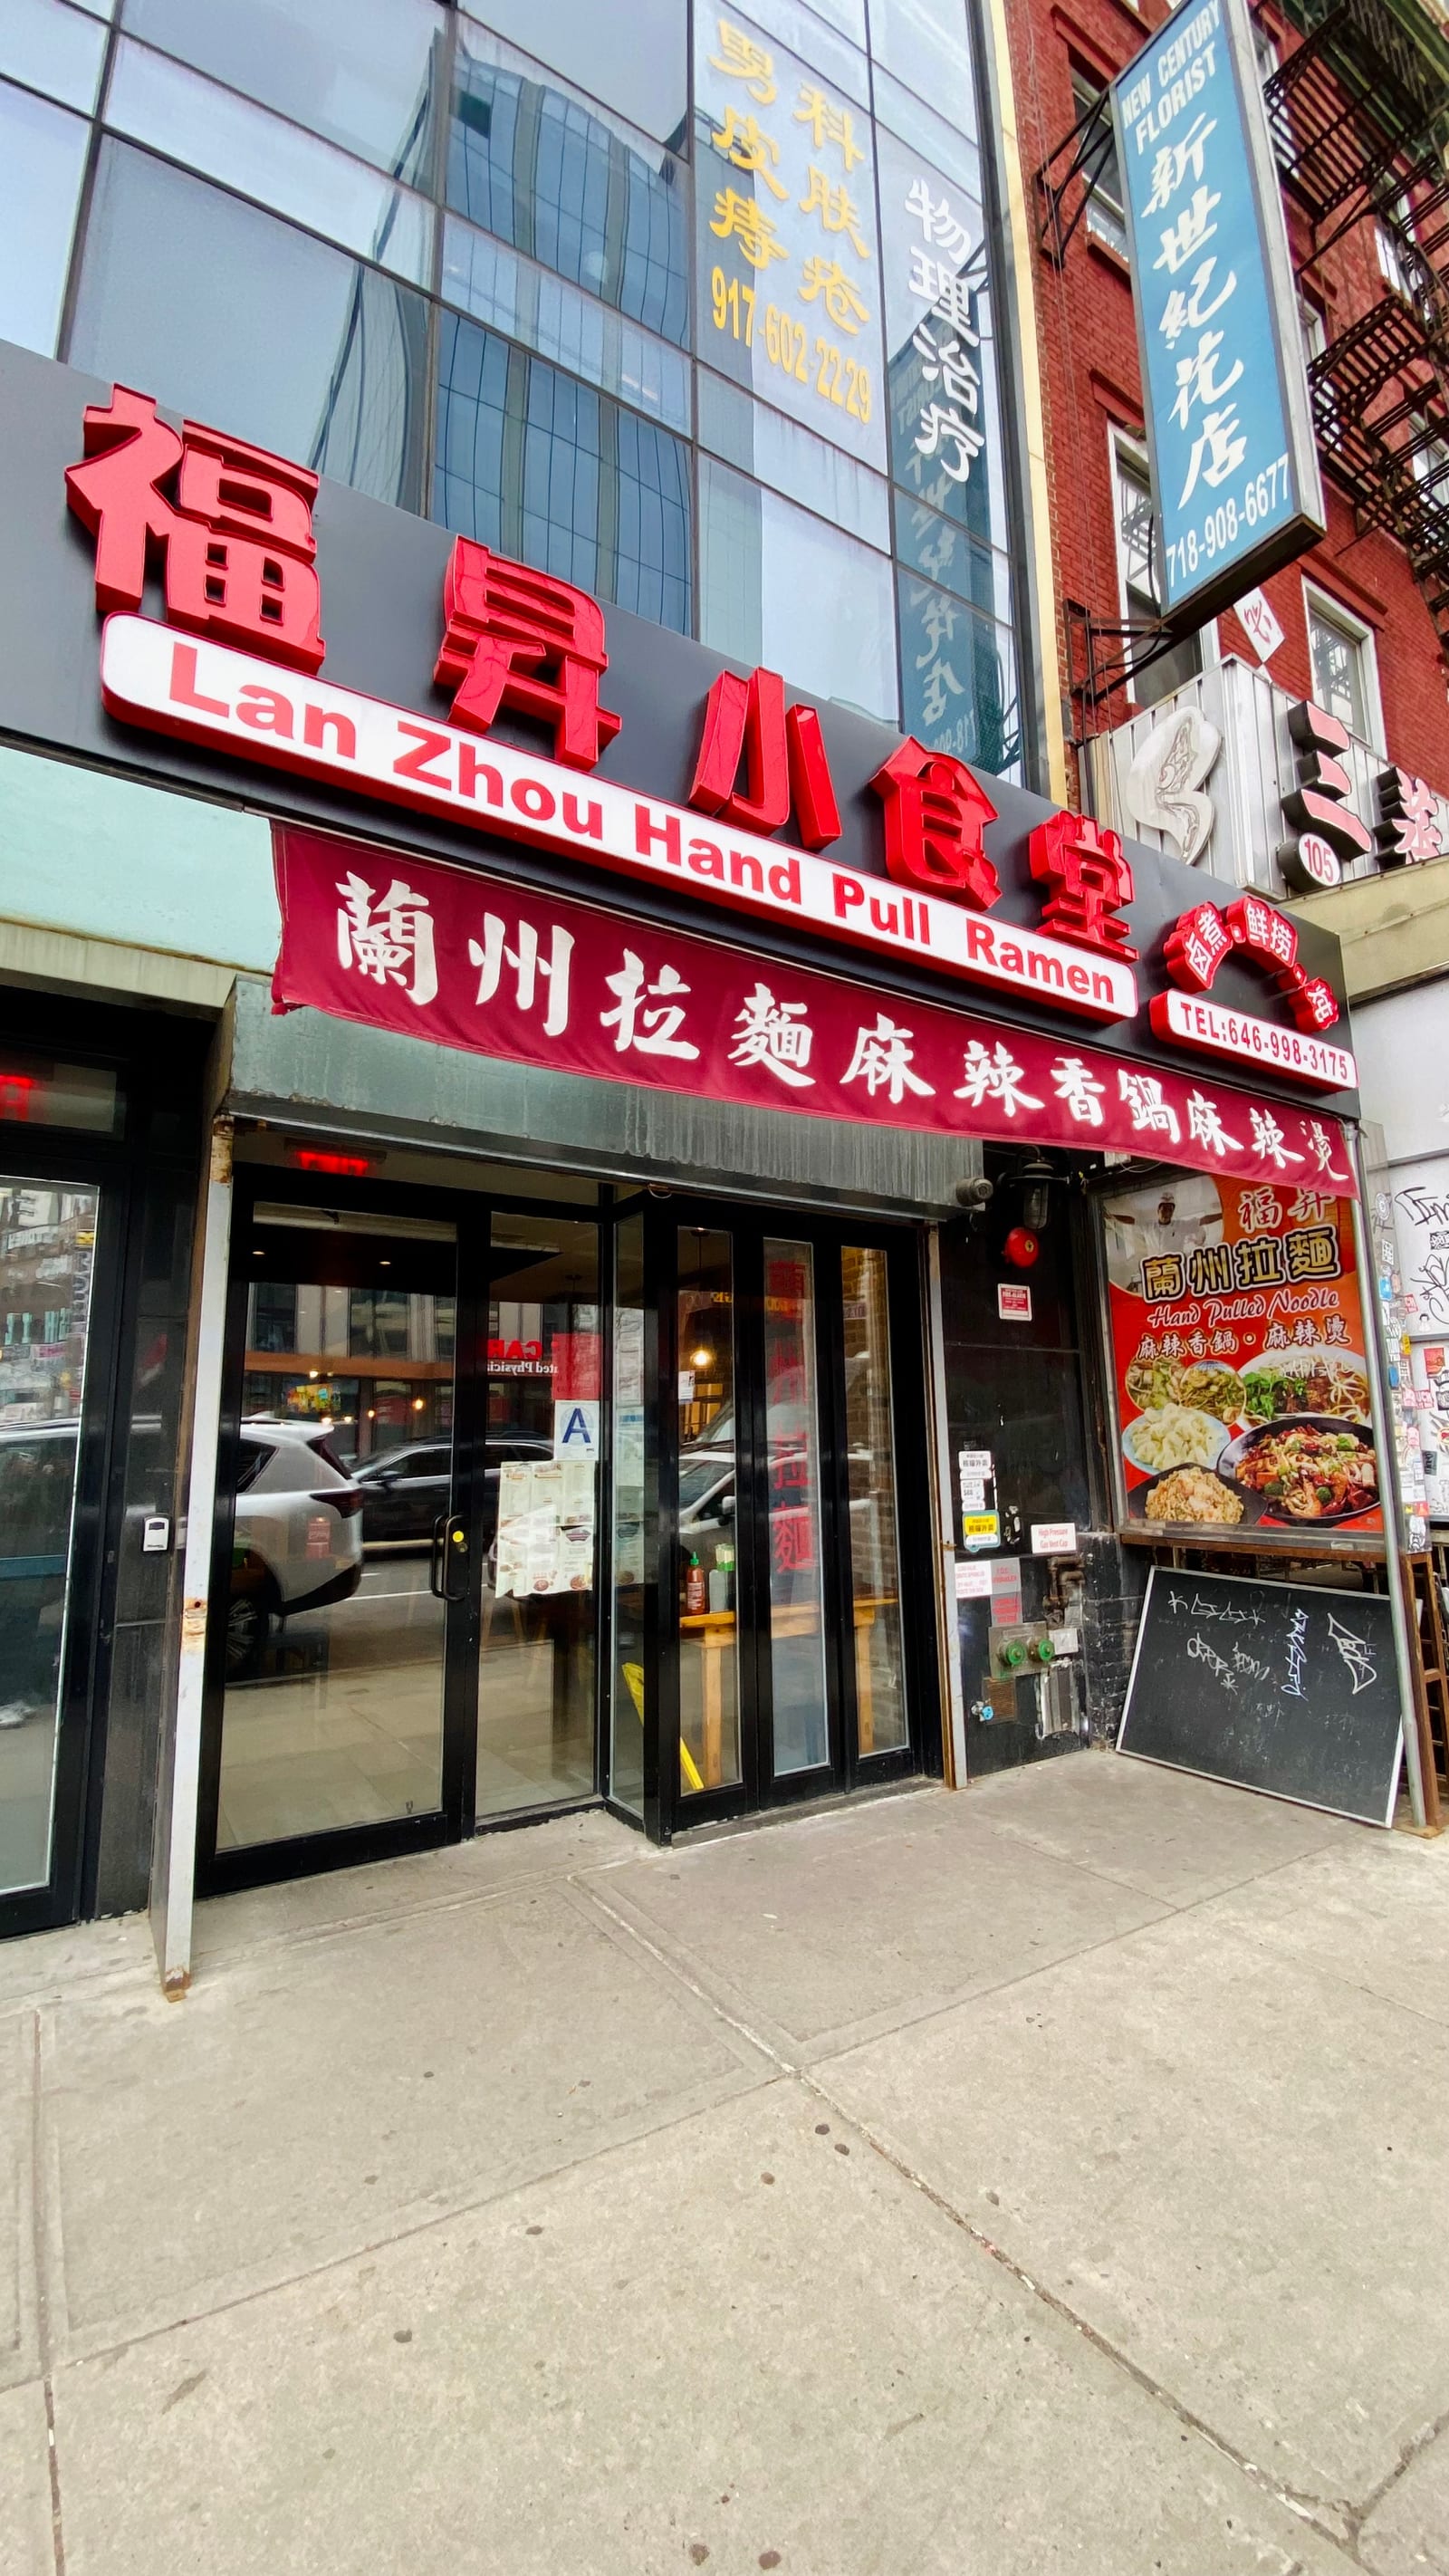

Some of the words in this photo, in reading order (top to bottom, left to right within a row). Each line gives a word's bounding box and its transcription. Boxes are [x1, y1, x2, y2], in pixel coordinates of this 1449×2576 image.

[1122, 72, 1151, 130] NEW
[1158, 0, 1220, 88] CENTURY
[1136, 41, 1215, 156] FLORIST
[1140, 111, 1247, 511] 新世纪花店
[1166, 453, 1290, 588] 718-908-6677
[168, 641, 356, 760] Lan
[392, 720, 604, 842] Zhou
[634, 803, 801, 905] Hand
[831, 872, 931, 947] Pull
[966, 919, 1115, 1005] Ramen
[1303, 835, 1335, 884] 105
[1144, 1227, 1340, 1300] 蘭州拉麵
[1147, 1304, 1201, 1329] Hand
[1203, 1294, 1266, 1329] Pulled
[1267, 1287, 1339, 1319] Noodle
[561, 1408, 591, 1444] A
